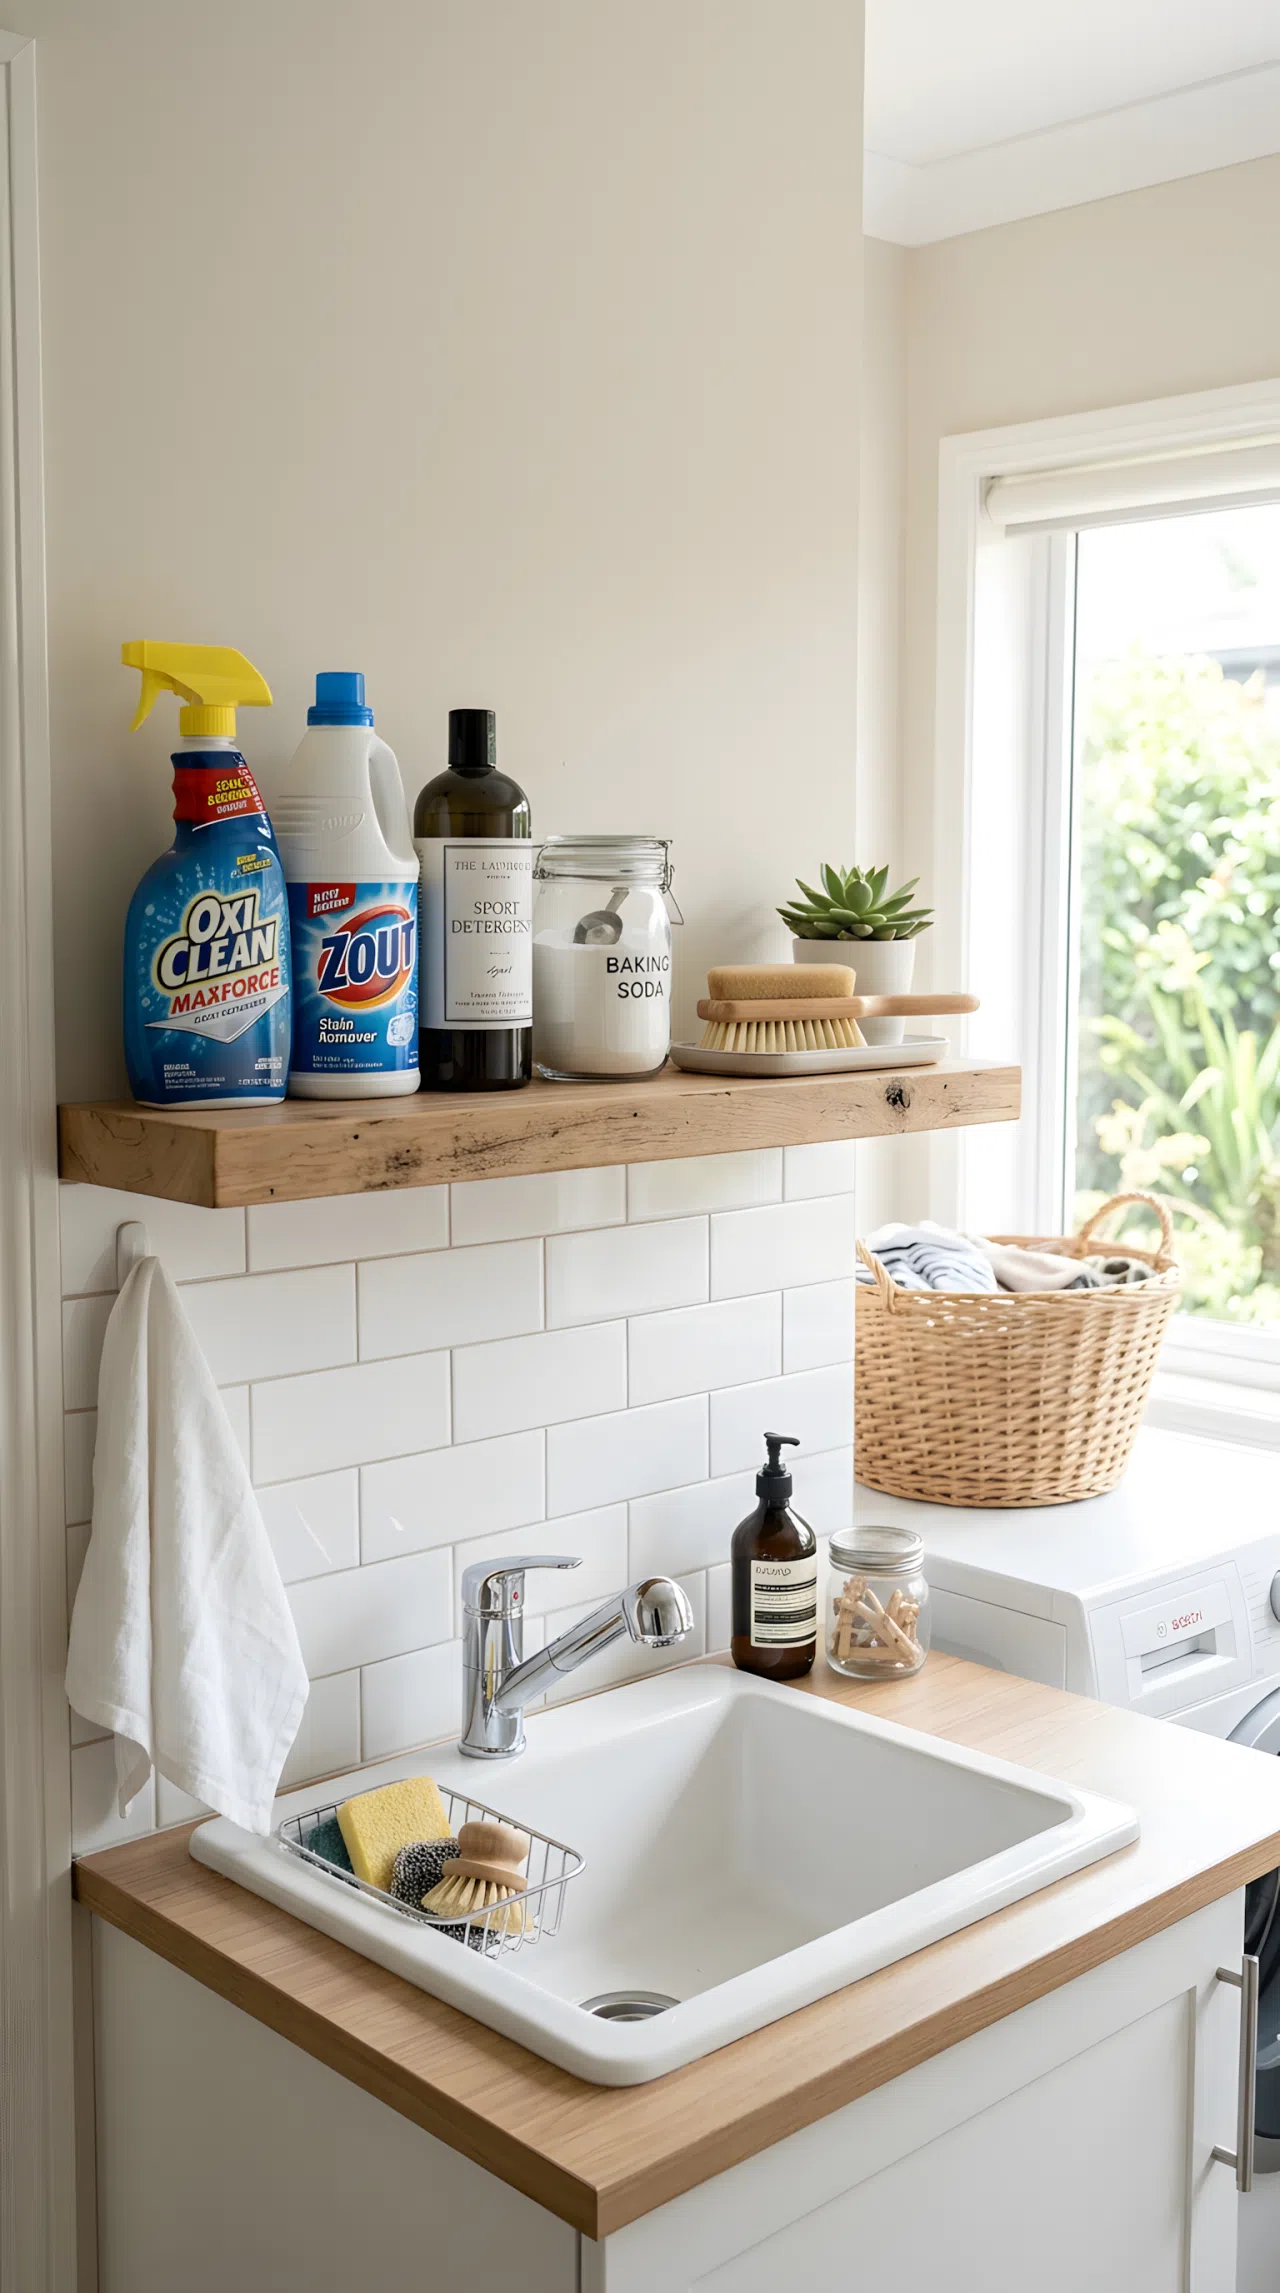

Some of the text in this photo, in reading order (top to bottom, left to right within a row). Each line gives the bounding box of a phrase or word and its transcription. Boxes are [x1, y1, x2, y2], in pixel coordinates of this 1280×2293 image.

[454, 861, 477, 871] THE
[188, 895, 256, 944] OXI
[473, 901, 520, 915] SPORT
[161, 923, 275, 986] CLEAN
[318, 919, 415, 994] ZOUT
[606, 956, 669, 974] BAKING
[171, 967, 280, 1015] MAXFORCE
[617, 982, 664, 998] SODA
